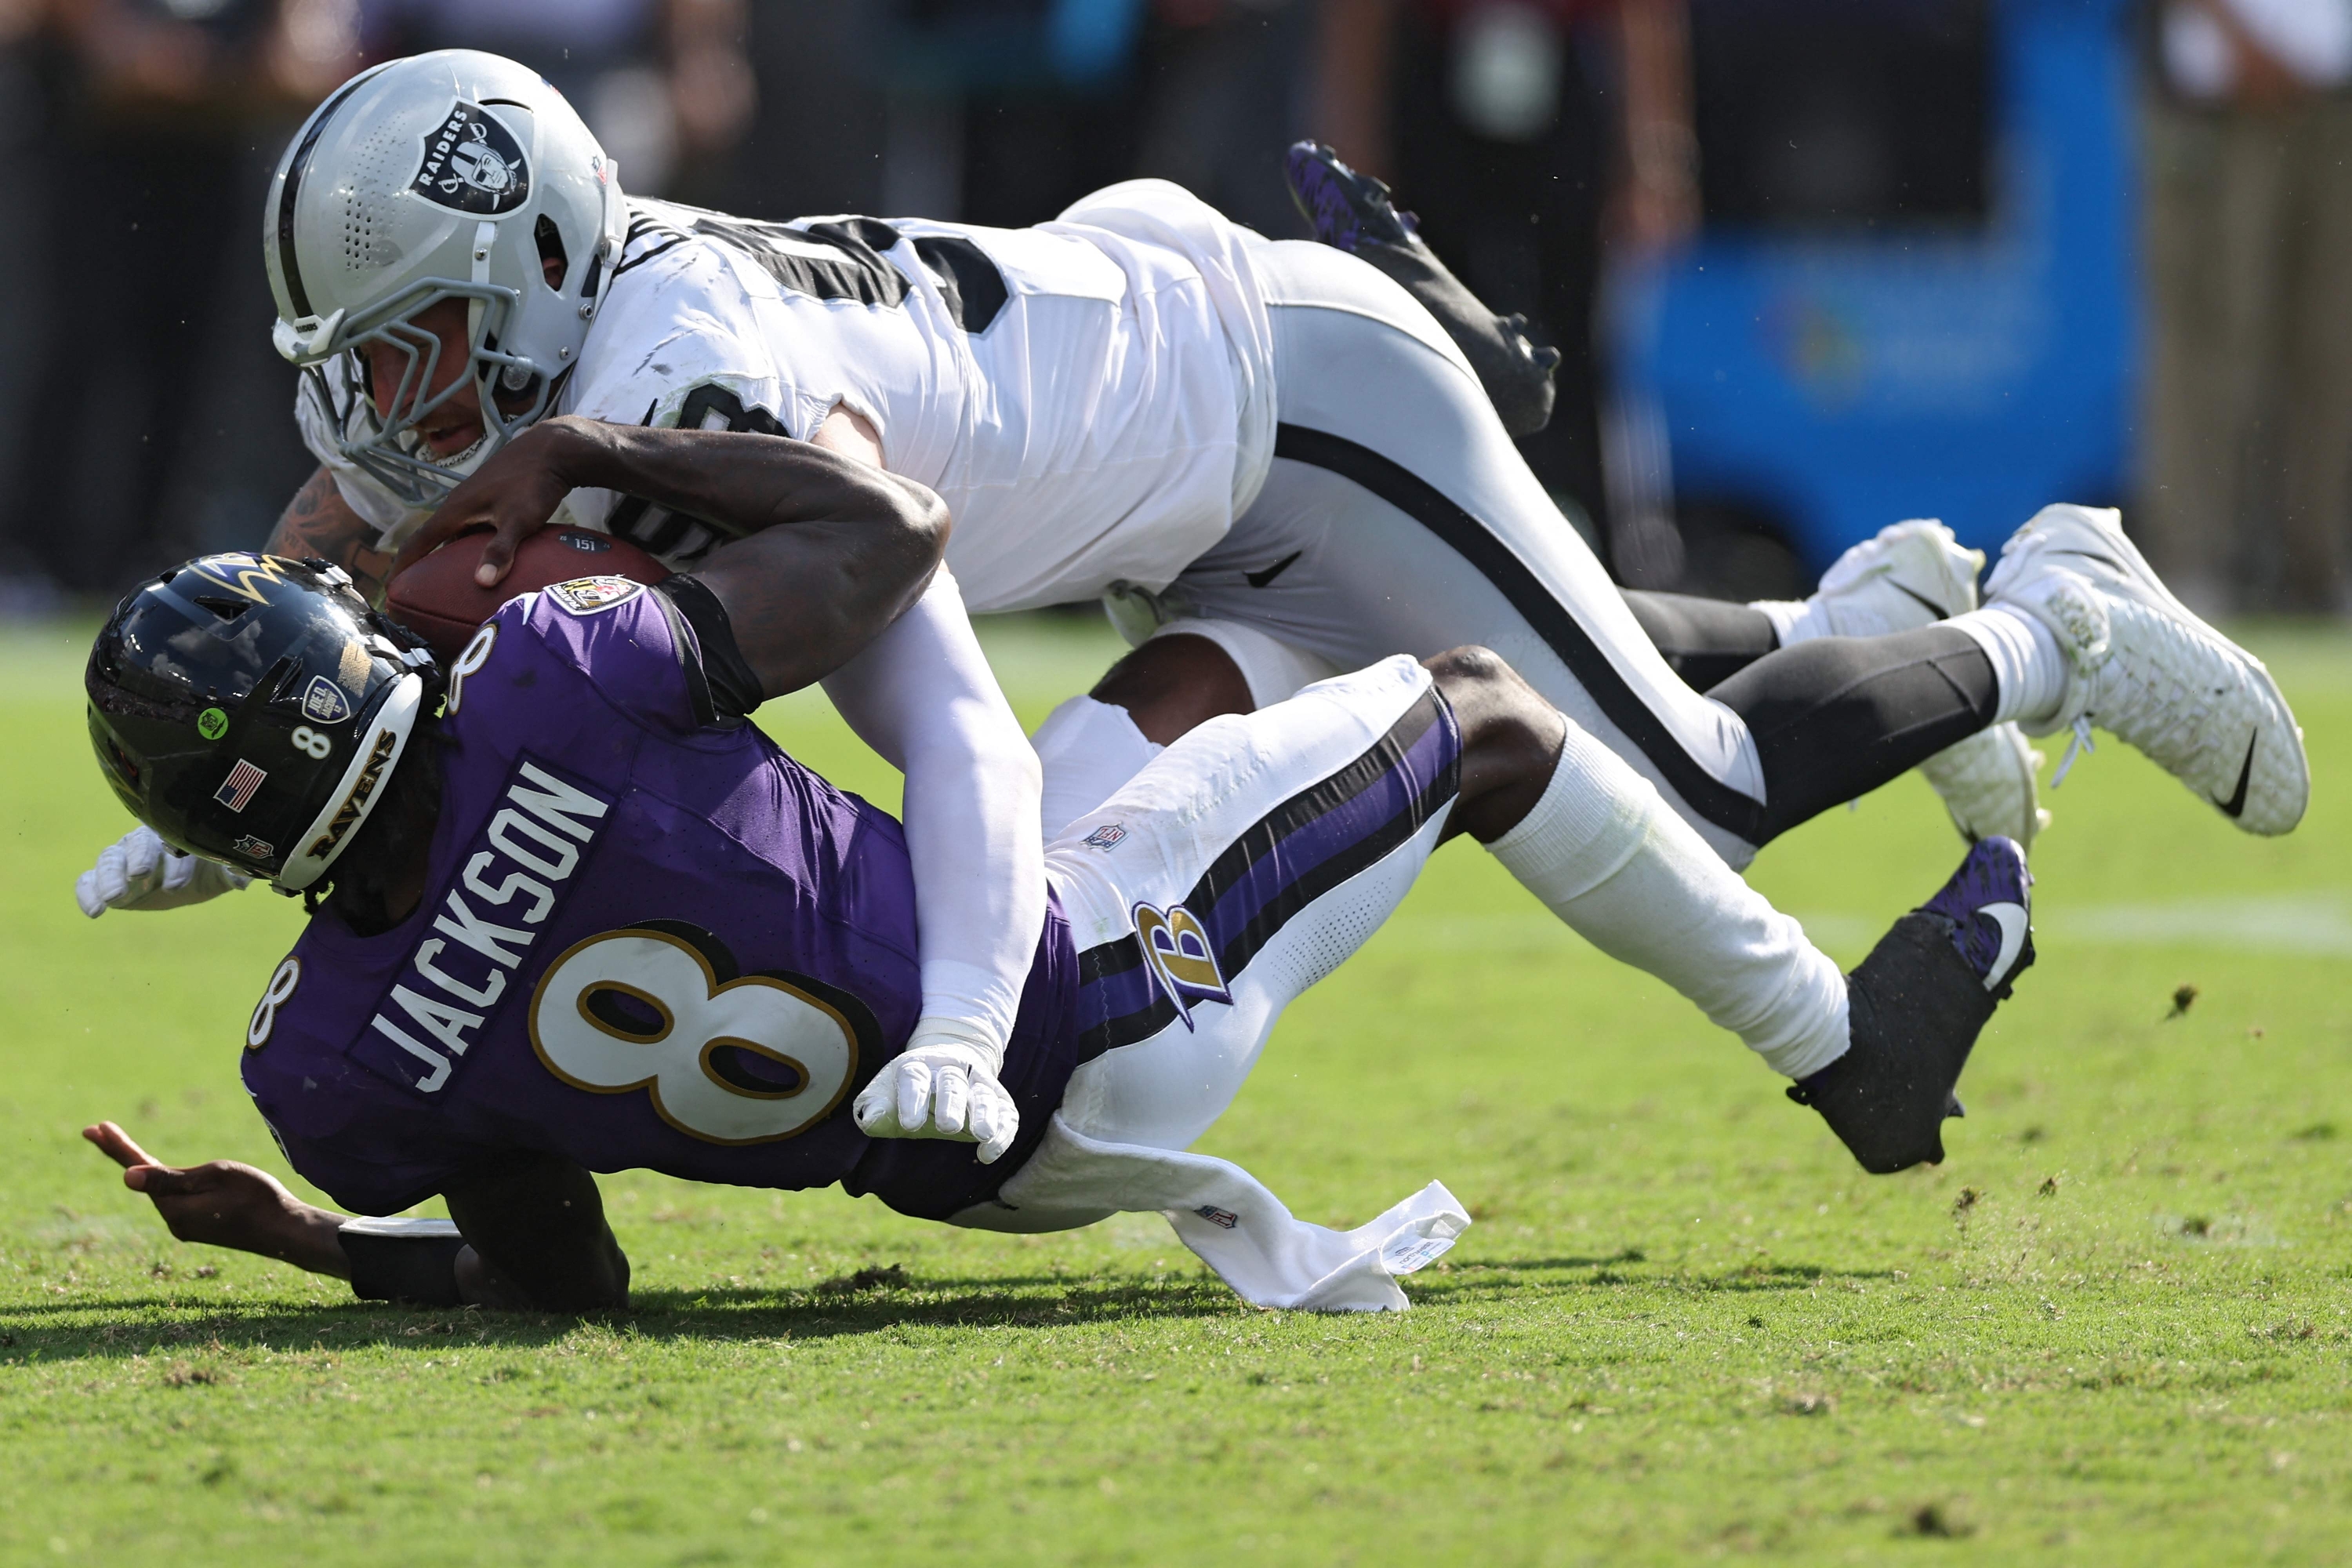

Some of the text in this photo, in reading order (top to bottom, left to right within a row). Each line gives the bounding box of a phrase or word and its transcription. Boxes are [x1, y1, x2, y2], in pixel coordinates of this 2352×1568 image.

[418, 110, 468, 187] RAIDERS
[575, 538, 595, 551] 151
[307, 693, 325, 714] JOE
[321, 691, 338, 719] JACOBY
[448, 622, 500, 716] 8
[291, 725, 332, 760] 8
[306, 728, 397, 862] RAVENS
[248, 844, 270, 857] NFL
[371, 760, 609, 1094] JACKSON
[246, 955, 302, 1051] 8
[528, 925, 869, 1146] 8
